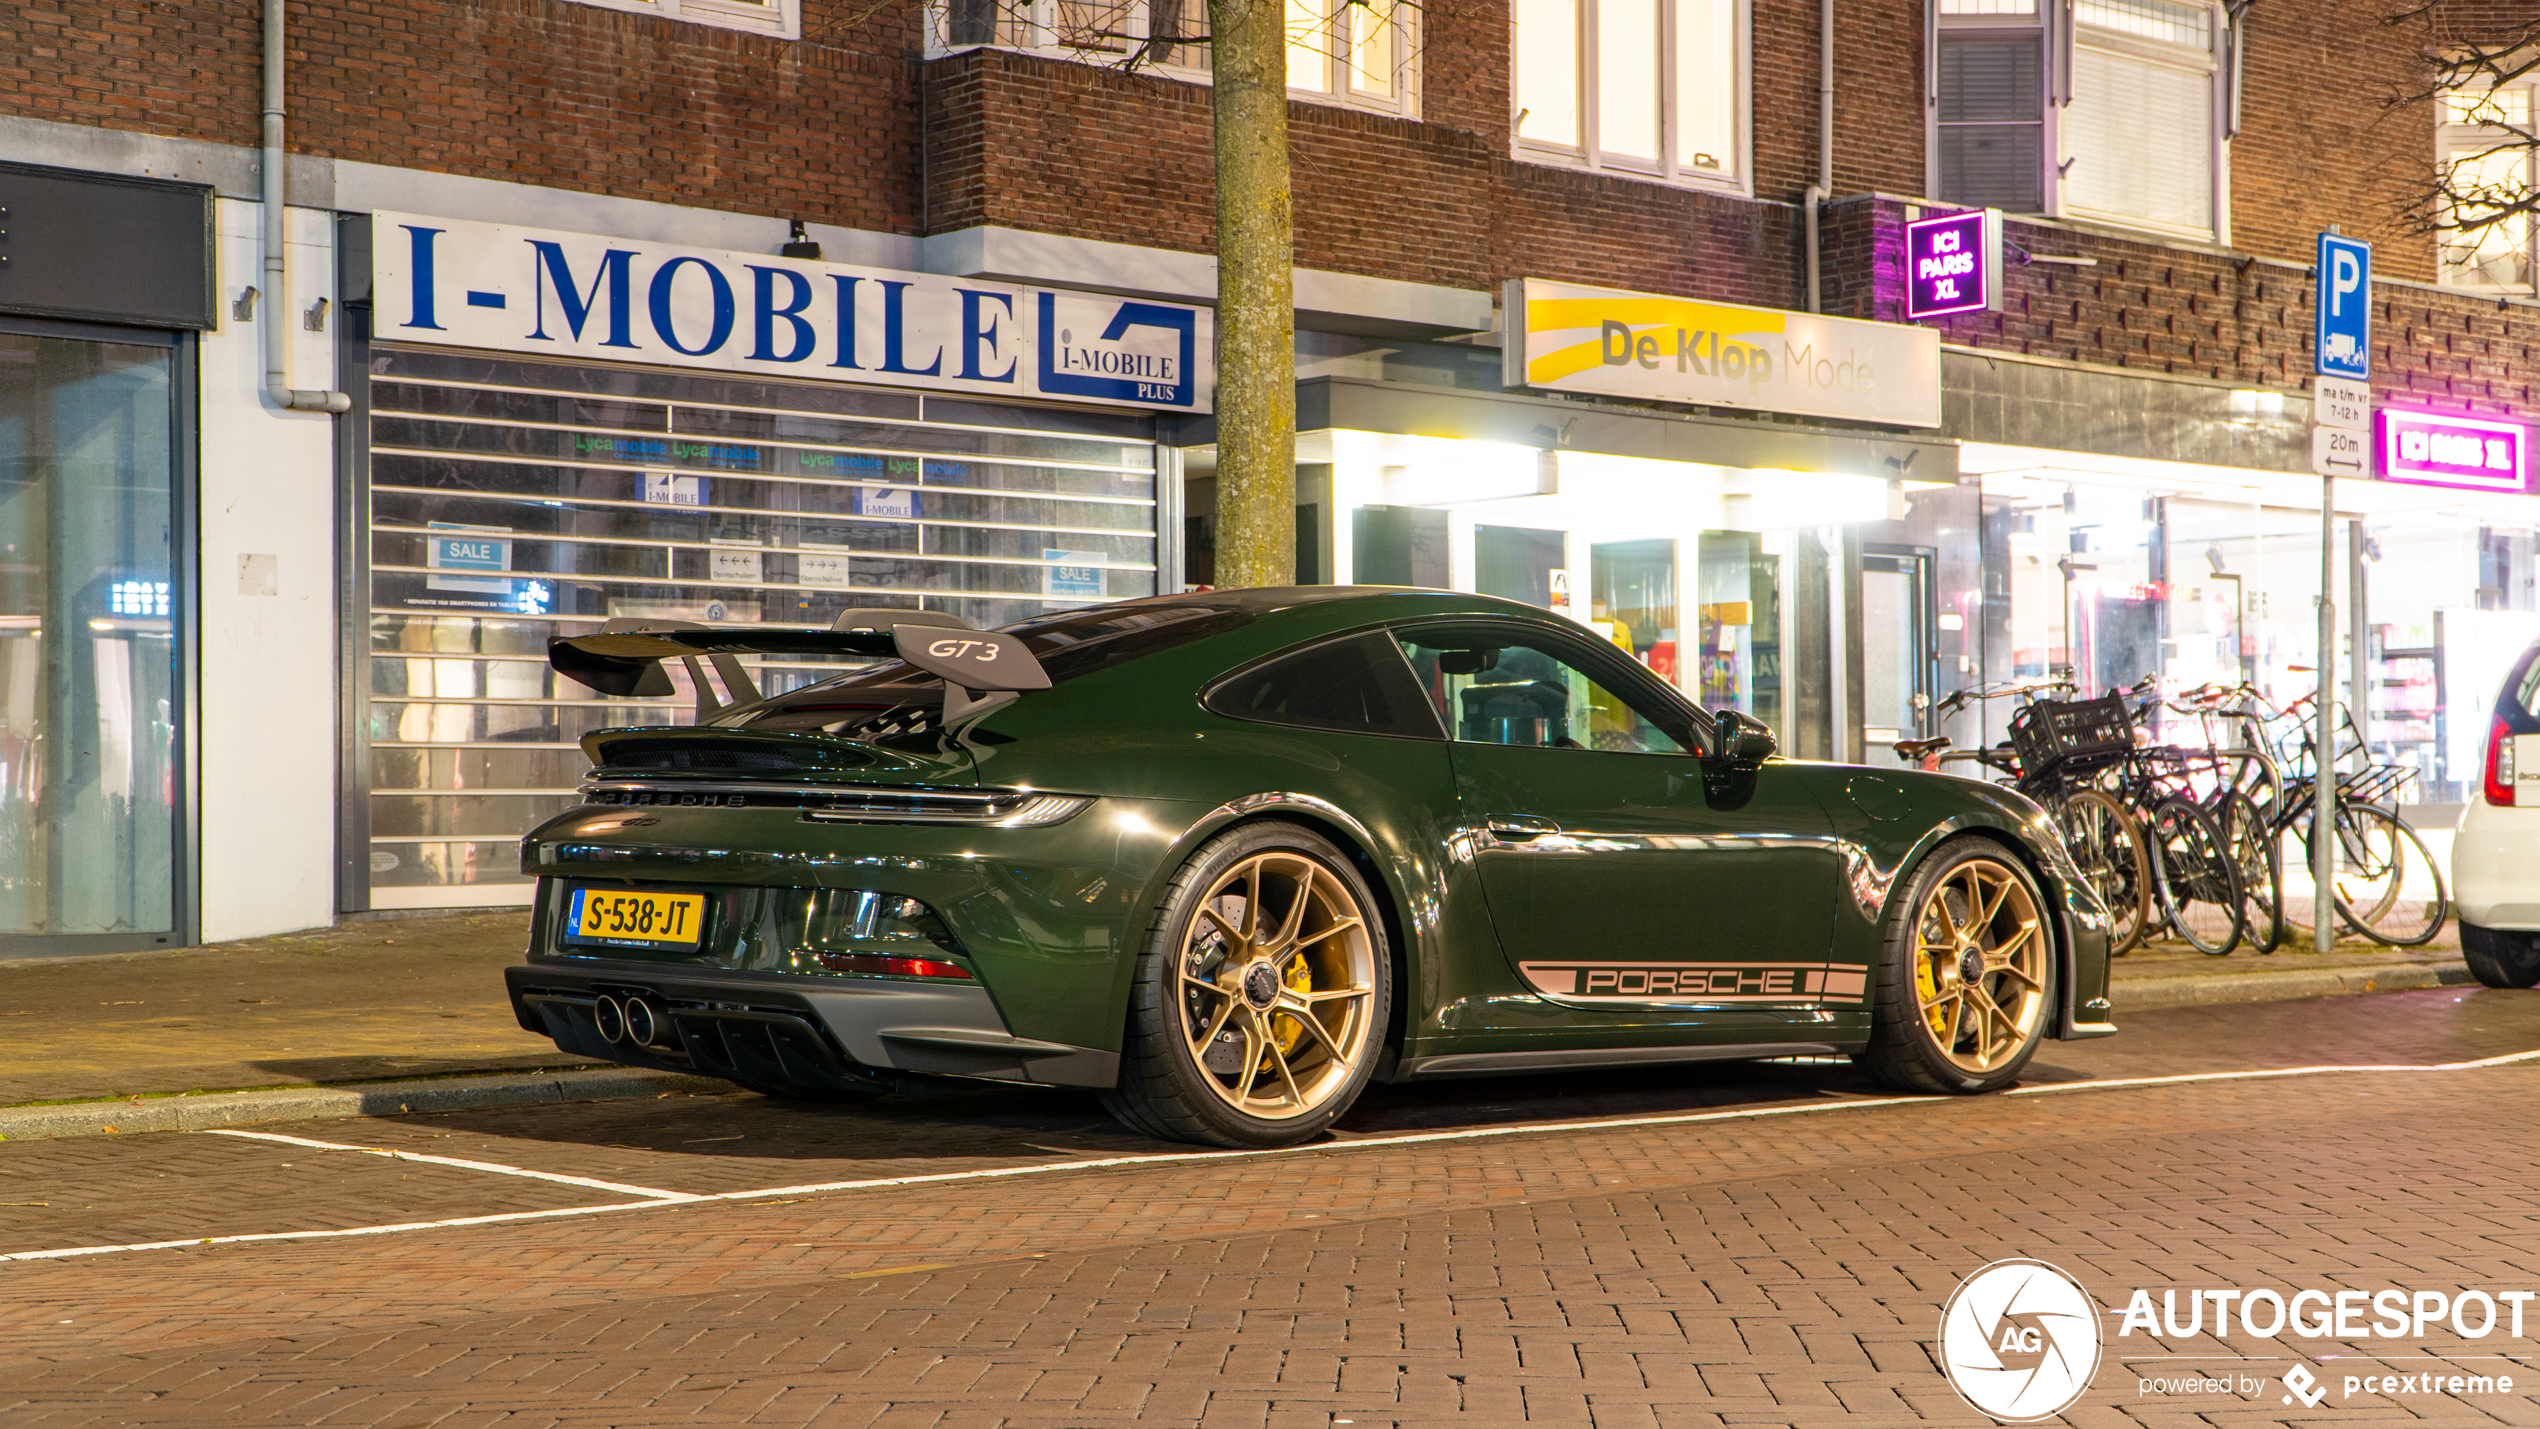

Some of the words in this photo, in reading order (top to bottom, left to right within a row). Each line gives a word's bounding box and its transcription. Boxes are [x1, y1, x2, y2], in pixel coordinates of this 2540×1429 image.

[1931, 230, 1960, 254] ICI
[1919, 251, 1974, 279] PARIS
[1934, 278, 1960, 301] XL
[2332, 248, 2360, 317] P
[399, 224, 1018, 384] I-MOBILE
[1062, 347, 1174, 380] I-MOBILE
[1602, 318, 1660, 371] De
[1677, 328, 1773, 396] Klop
[1784, 340, 1875, 395] Mode
[1138, 383, 1175, 401] PLUS
[2323, 386, 2337, 399] ma
[2339, 388, 2357, 402] t/m
[2357, 393, 2368, 404] vr
[2331, 405, 2351, 420] 7-12
[2352, 408, 2359, 421] h
[575, 434, 668, 455] Lycamobile
[673, 440, 761, 461] Lycamobile
[2330, 433, 2359, 453] 20m
[801, 451, 884, 471] Lycamobile
[865, 504, 911, 517] I-MOBILE
[449, 542, 491, 560] SALE
[713, 570, 757, 580] Openschuiven
[800, 574, 844, 584] Openschuiven
[1059, 567, 1091, 581] SALE
[604, 793, 747, 807] PORSCHE
[570, 918, 579, 928] NL
[588, 897, 690, 936] S-538-JT
[1586, 970, 1796, 994] PORSCHE
